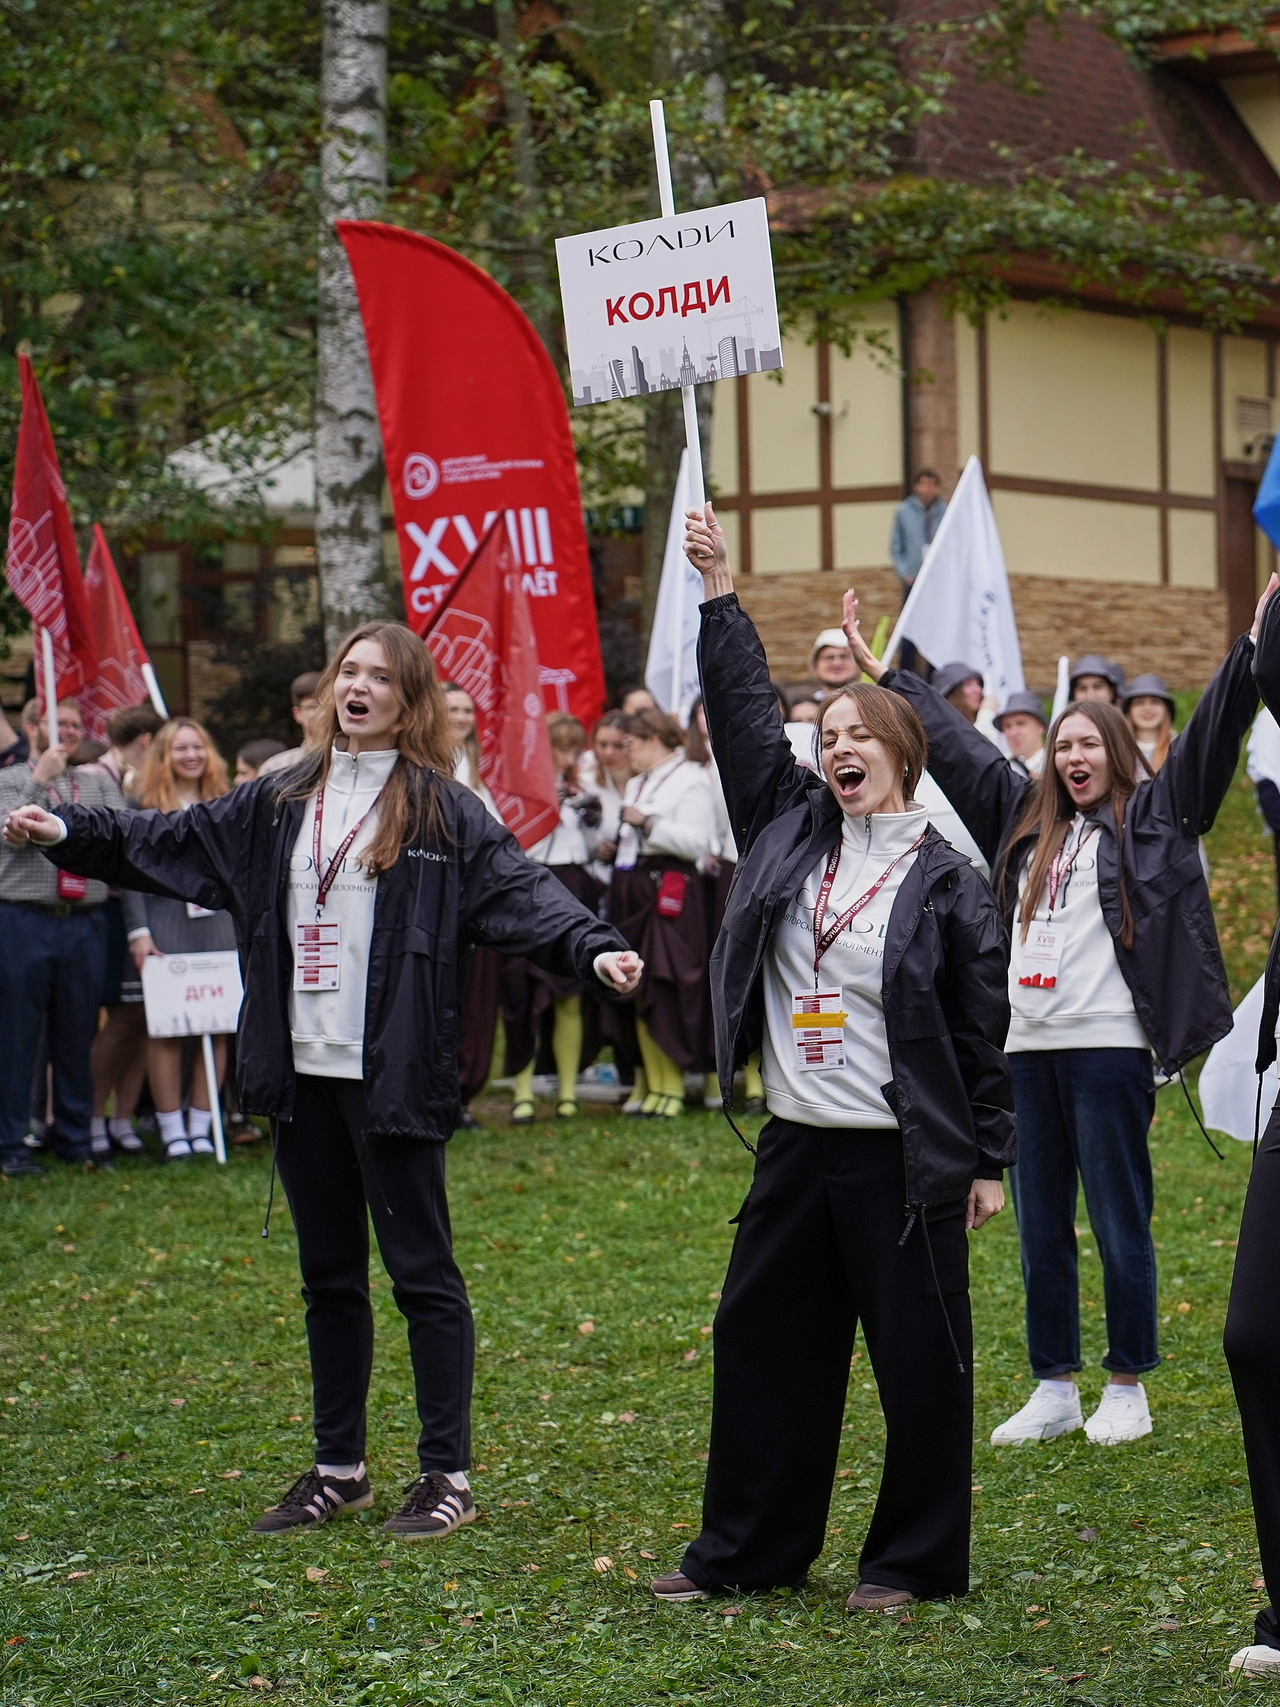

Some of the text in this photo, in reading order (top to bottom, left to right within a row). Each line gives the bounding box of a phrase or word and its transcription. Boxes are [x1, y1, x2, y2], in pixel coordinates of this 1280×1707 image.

[588, 219, 735, 267] КОЛДИ
[606, 275, 731, 326] КОЛДИ
[828, 854, 837, 874] ГОРОДА
[815, 895, 827, 930] ФУНДАМЕНТ
[825, 910, 852, 942] ФУНДАМЕНТ
[850, 894, 871, 916] ГОРОДА
[185, 984, 224, 1002] ДГИ
